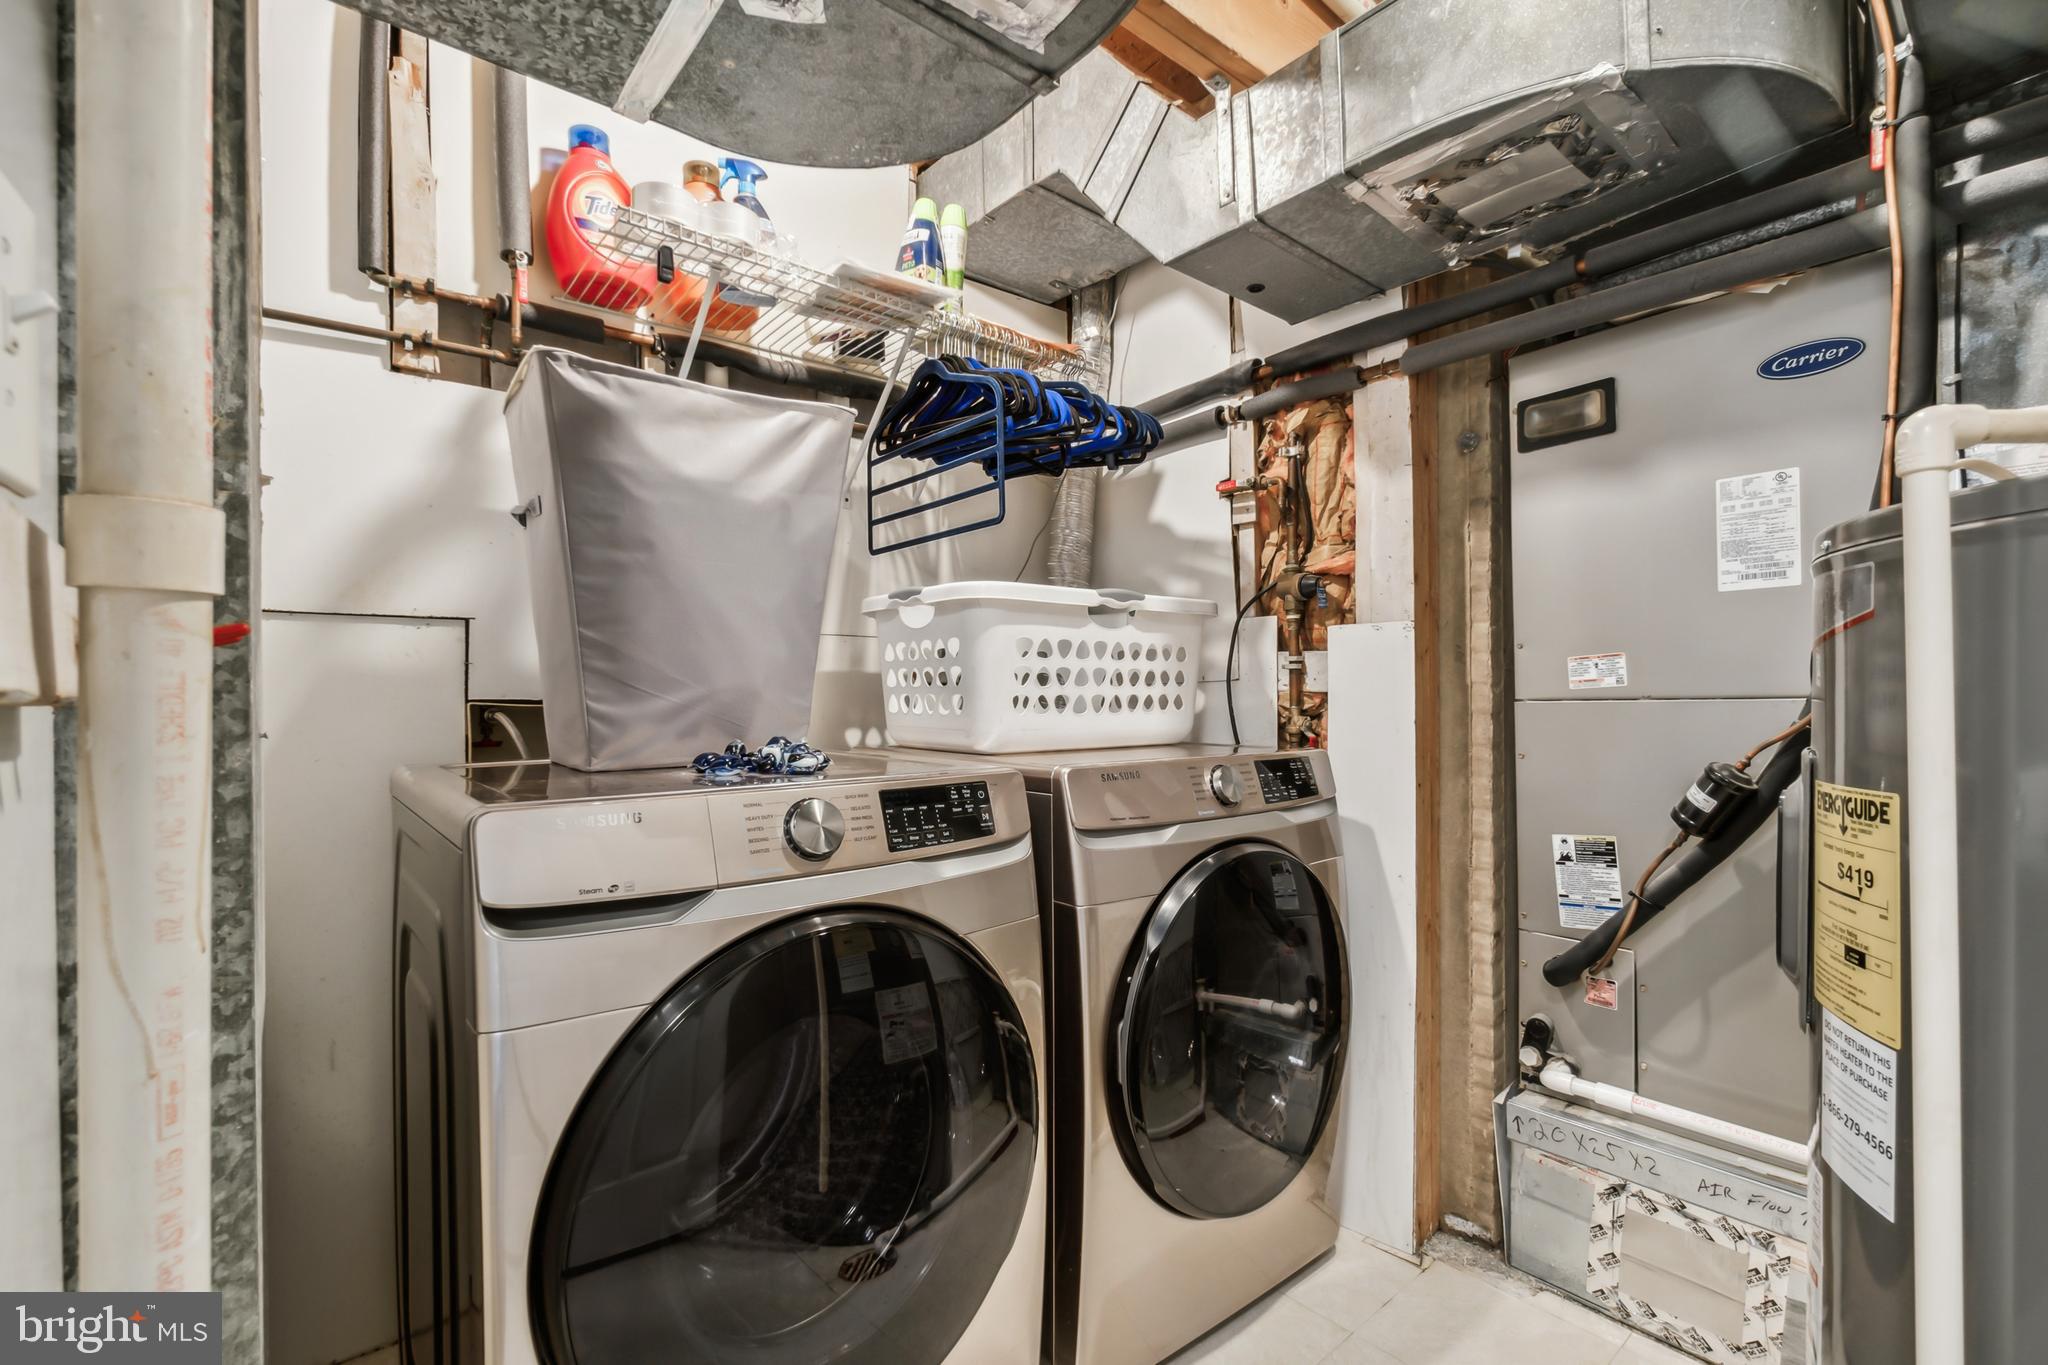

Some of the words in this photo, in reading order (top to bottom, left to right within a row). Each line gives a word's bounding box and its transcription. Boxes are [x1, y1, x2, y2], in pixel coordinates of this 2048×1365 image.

[1771, 345, 1849, 371] Carrier
[1837, 861, 1874, 889] $419
[578, 887, 603, 895] Steam
[1832, 1025, 1844, 1040] NOT
[1845, 1034, 1871, 1059] RETURN
[1872, 1051, 1892, 1070] THIS
[1825, 1049, 1839, 1068] PLACE
[1841, 1062, 1849, 1073] OF
[1850, 1068, 1888, 1102] PURCHASE
[1840, 1046, 1863, 1070] HEATER
[1865, 1063, 1875, 1077] TO
[1876, 1070, 1894, 1088] THE
[1823, 1093, 1893, 1160] 1-866-279-4566
[1697, 1178, 1737, 1200] AIR
[1746, 1277, 1755, 1285] DC
